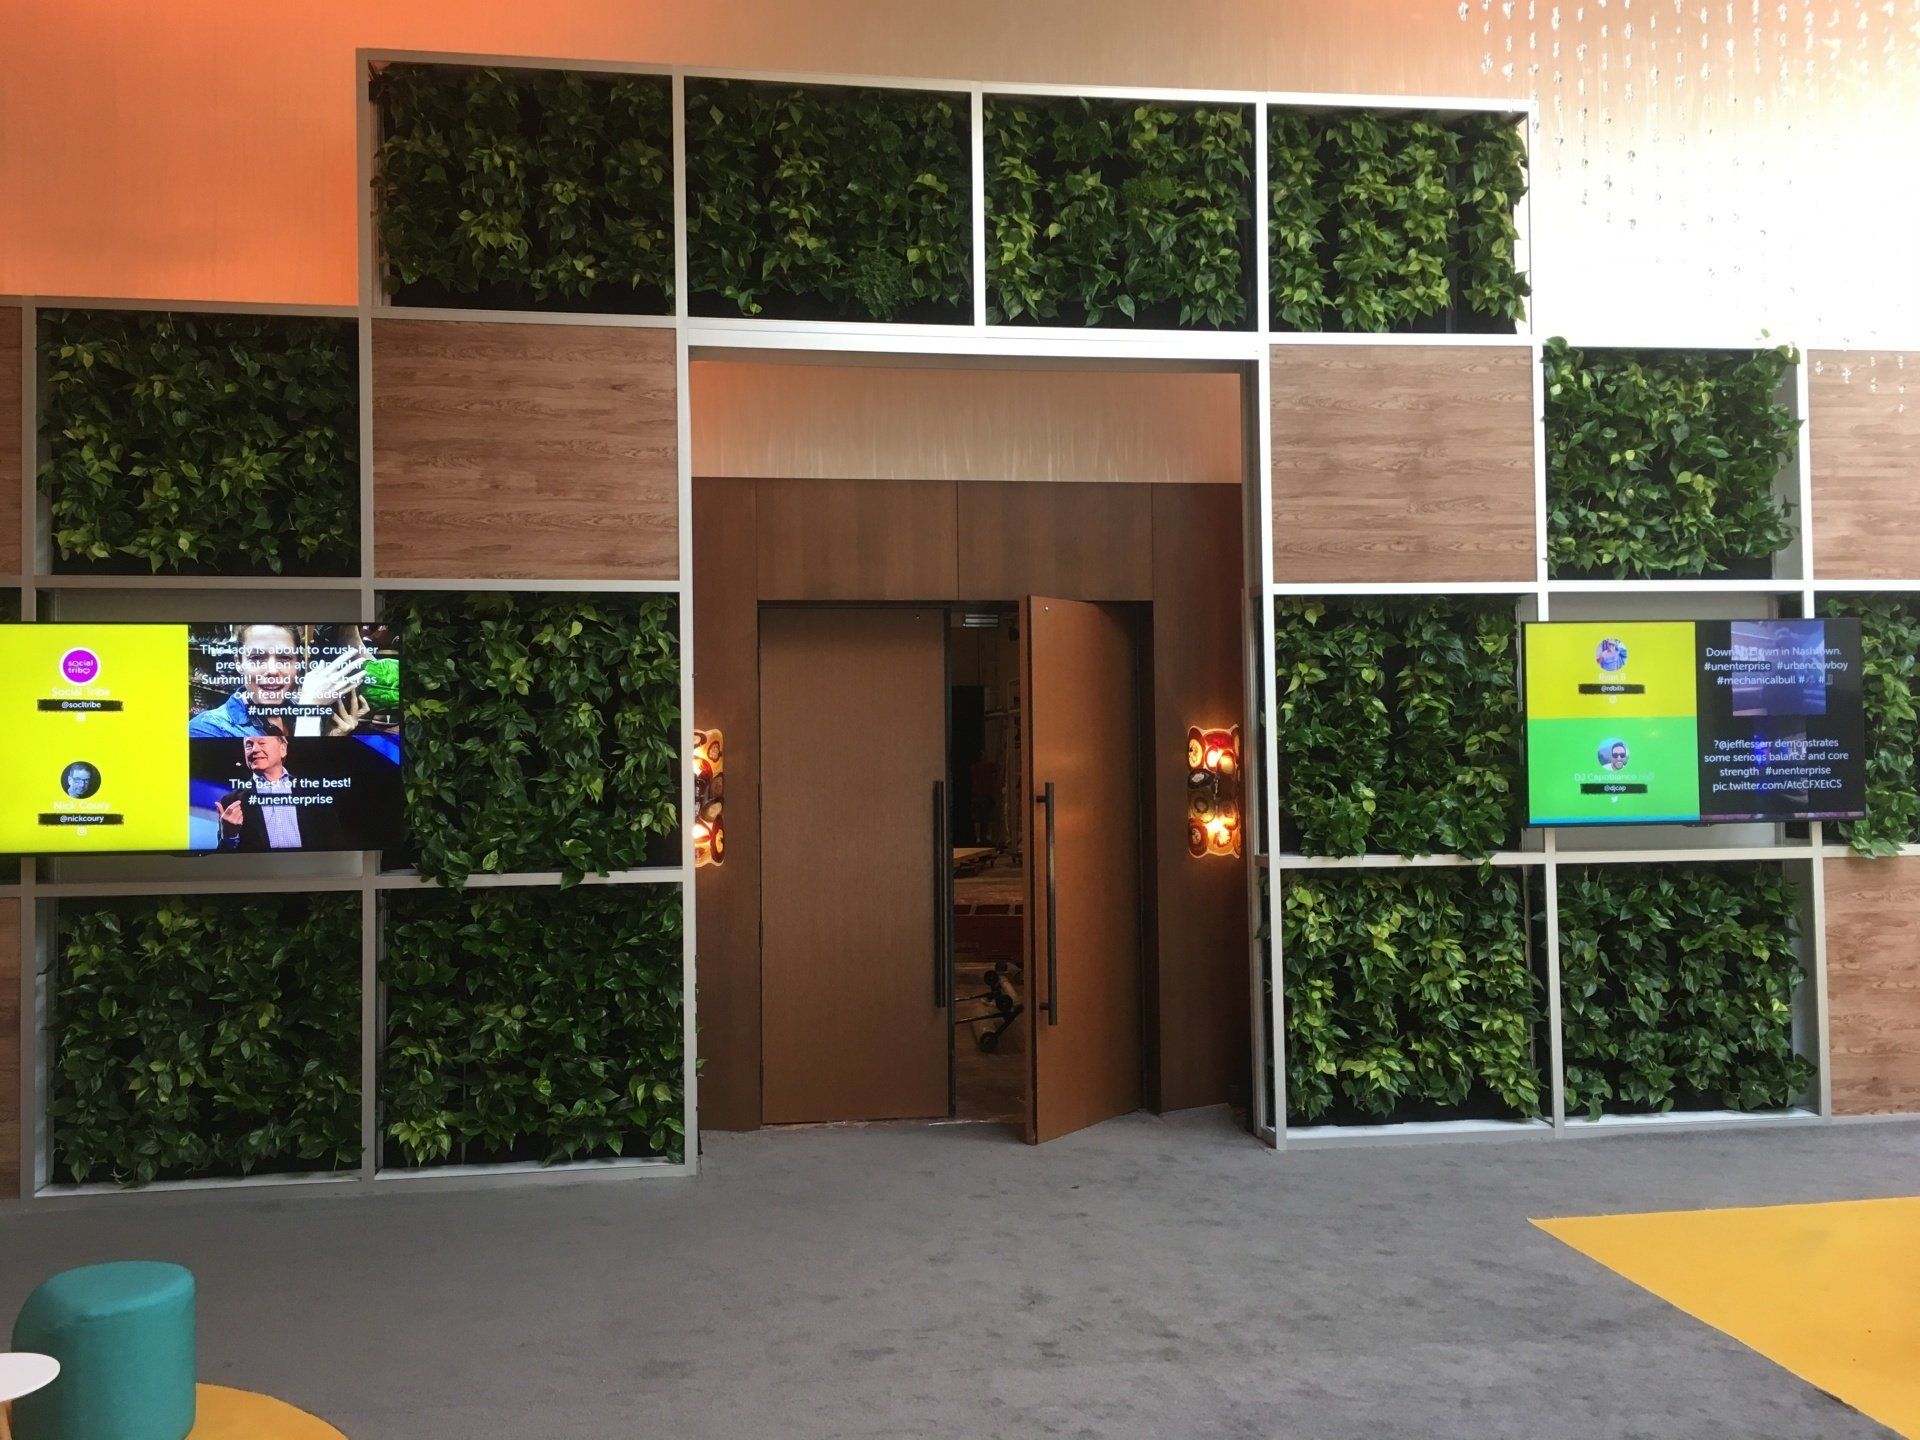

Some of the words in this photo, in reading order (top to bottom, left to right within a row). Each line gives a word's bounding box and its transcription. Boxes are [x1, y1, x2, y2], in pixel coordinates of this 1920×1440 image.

[200, 644, 225, 655] This
[256, 645, 265, 655] is
[269, 645, 304, 655] about
[307, 645, 320, 655] to
[359, 645, 378, 655] her
[1706, 647, 1735, 657] Down
[1781, 646, 1790, 656] in
[295, 660, 305, 670] at
[1704, 661, 1771, 672] #unenterprise
[1777, 660, 1849, 672] #urbancowboy
[201, 674, 252, 684] Summit!
[255, 674, 291, 684] Proud
[364, 675, 377, 684] as
[1716, 675, 1796, 685] #mechanicalbull
[234, 690, 256, 699] our
[258, 689, 303, 699] fearless
[248, 704, 333, 717] #unenterprise
[1774, 738, 1839, 748] demonstrates
[1704, 754, 1731, 763] some
[1732, 752, 1767, 762] serious
[1769, 751, 1806, 761] balance
[1807, 751, 1826, 761] and
[1827, 752, 1849, 760] core
[1720, 766, 1760, 778] strength
[1765, 765, 1832, 777] #unenterprise
[229, 778, 252, 789] The
[255, 778, 281, 789] best
[285, 778, 297, 788] of
[300, 777, 320, 788] the
[322, 777, 352, 788] best!
[248, 793, 333, 806] #unenterprise
[60, 814, 104, 823] @nickcoury
